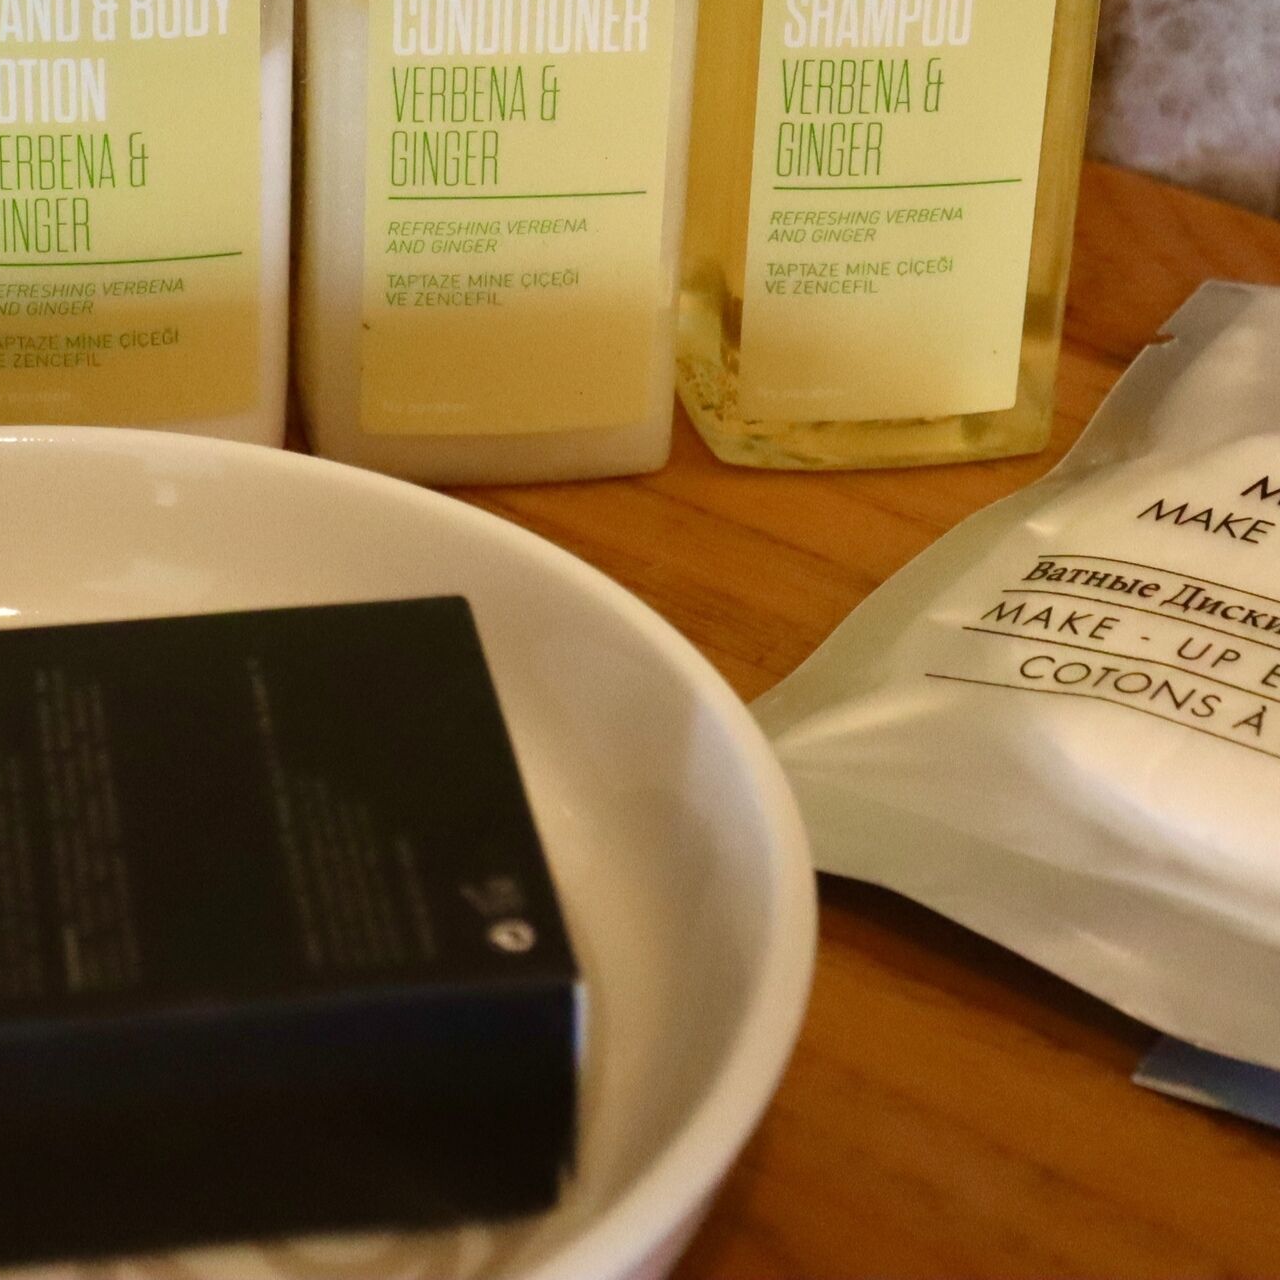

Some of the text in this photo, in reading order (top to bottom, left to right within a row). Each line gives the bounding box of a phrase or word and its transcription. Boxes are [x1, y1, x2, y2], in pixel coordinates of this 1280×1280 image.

[392, 64, 561, 123] VERBENA &
[782, 57, 944, 115] VERBENA &
[129, 131, 149, 188] &
[391, 130, 499, 186] GINGER
[776, 122, 883, 177] GINGER
[769, 207, 963, 226] REFRESHING VERBENA
[387, 218, 588, 237] REFRESHING VERBENA
[767, 228, 877, 243] AND GINGER
[385, 238, 498, 254] AND GINGER
[766, 262, 840, 278] TAPTAZE
[845, 259, 891, 277] MİNE
[102, 277, 185, 296] VERBENA
[387, 273, 462, 290] TAPTAZE
[467, 270, 514, 288] MİNE
[765, 280, 786, 295] VE
[26, 300, 94, 316] GINGER
[386, 292, 408, 307] VE
[1137, 498, 1276, 545] MAKE
[1021, 561, 1161, 600] Ватные
[980, 600, 1120, 641] MAKE
[1176, 636, 1242, 668] UP
[1019, 654, 1222, 720] COTONS
[1232, 705, 1266, 742] À
